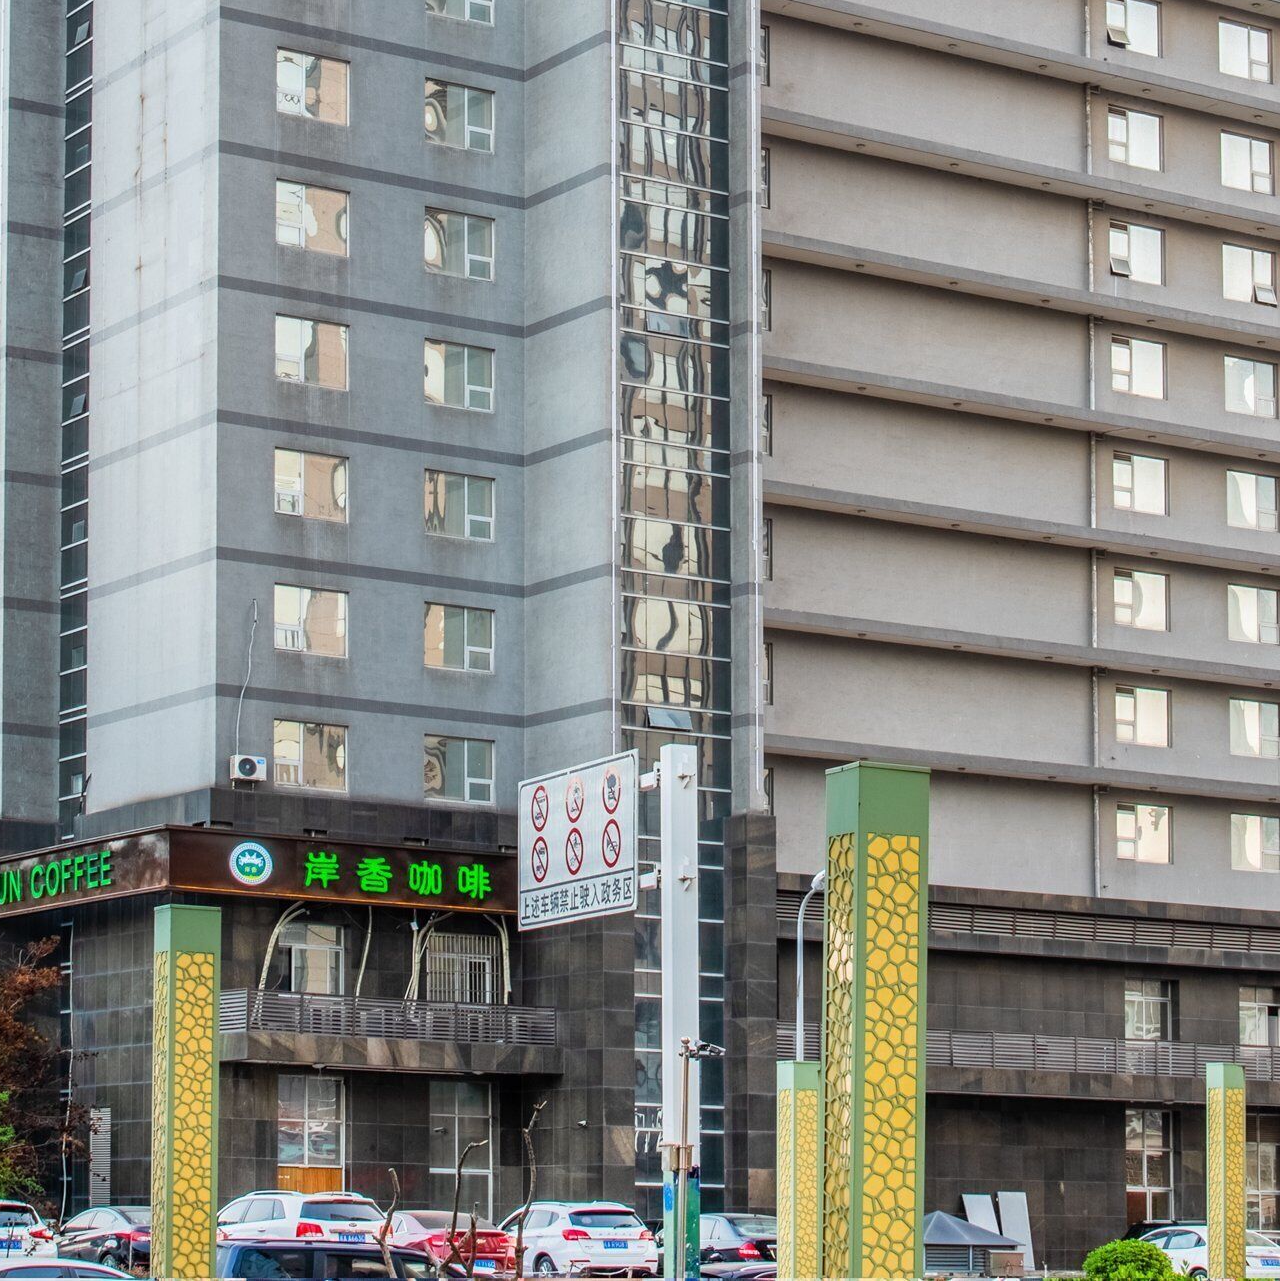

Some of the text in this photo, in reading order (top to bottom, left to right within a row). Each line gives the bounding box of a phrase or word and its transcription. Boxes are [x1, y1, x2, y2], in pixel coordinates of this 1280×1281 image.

[30, 850, 112, 899] COFFEE
[304, 851, 492, 900] 岸香咖啡
[521, 876, 632, 920] 上述车辆禁止驶入政务区
